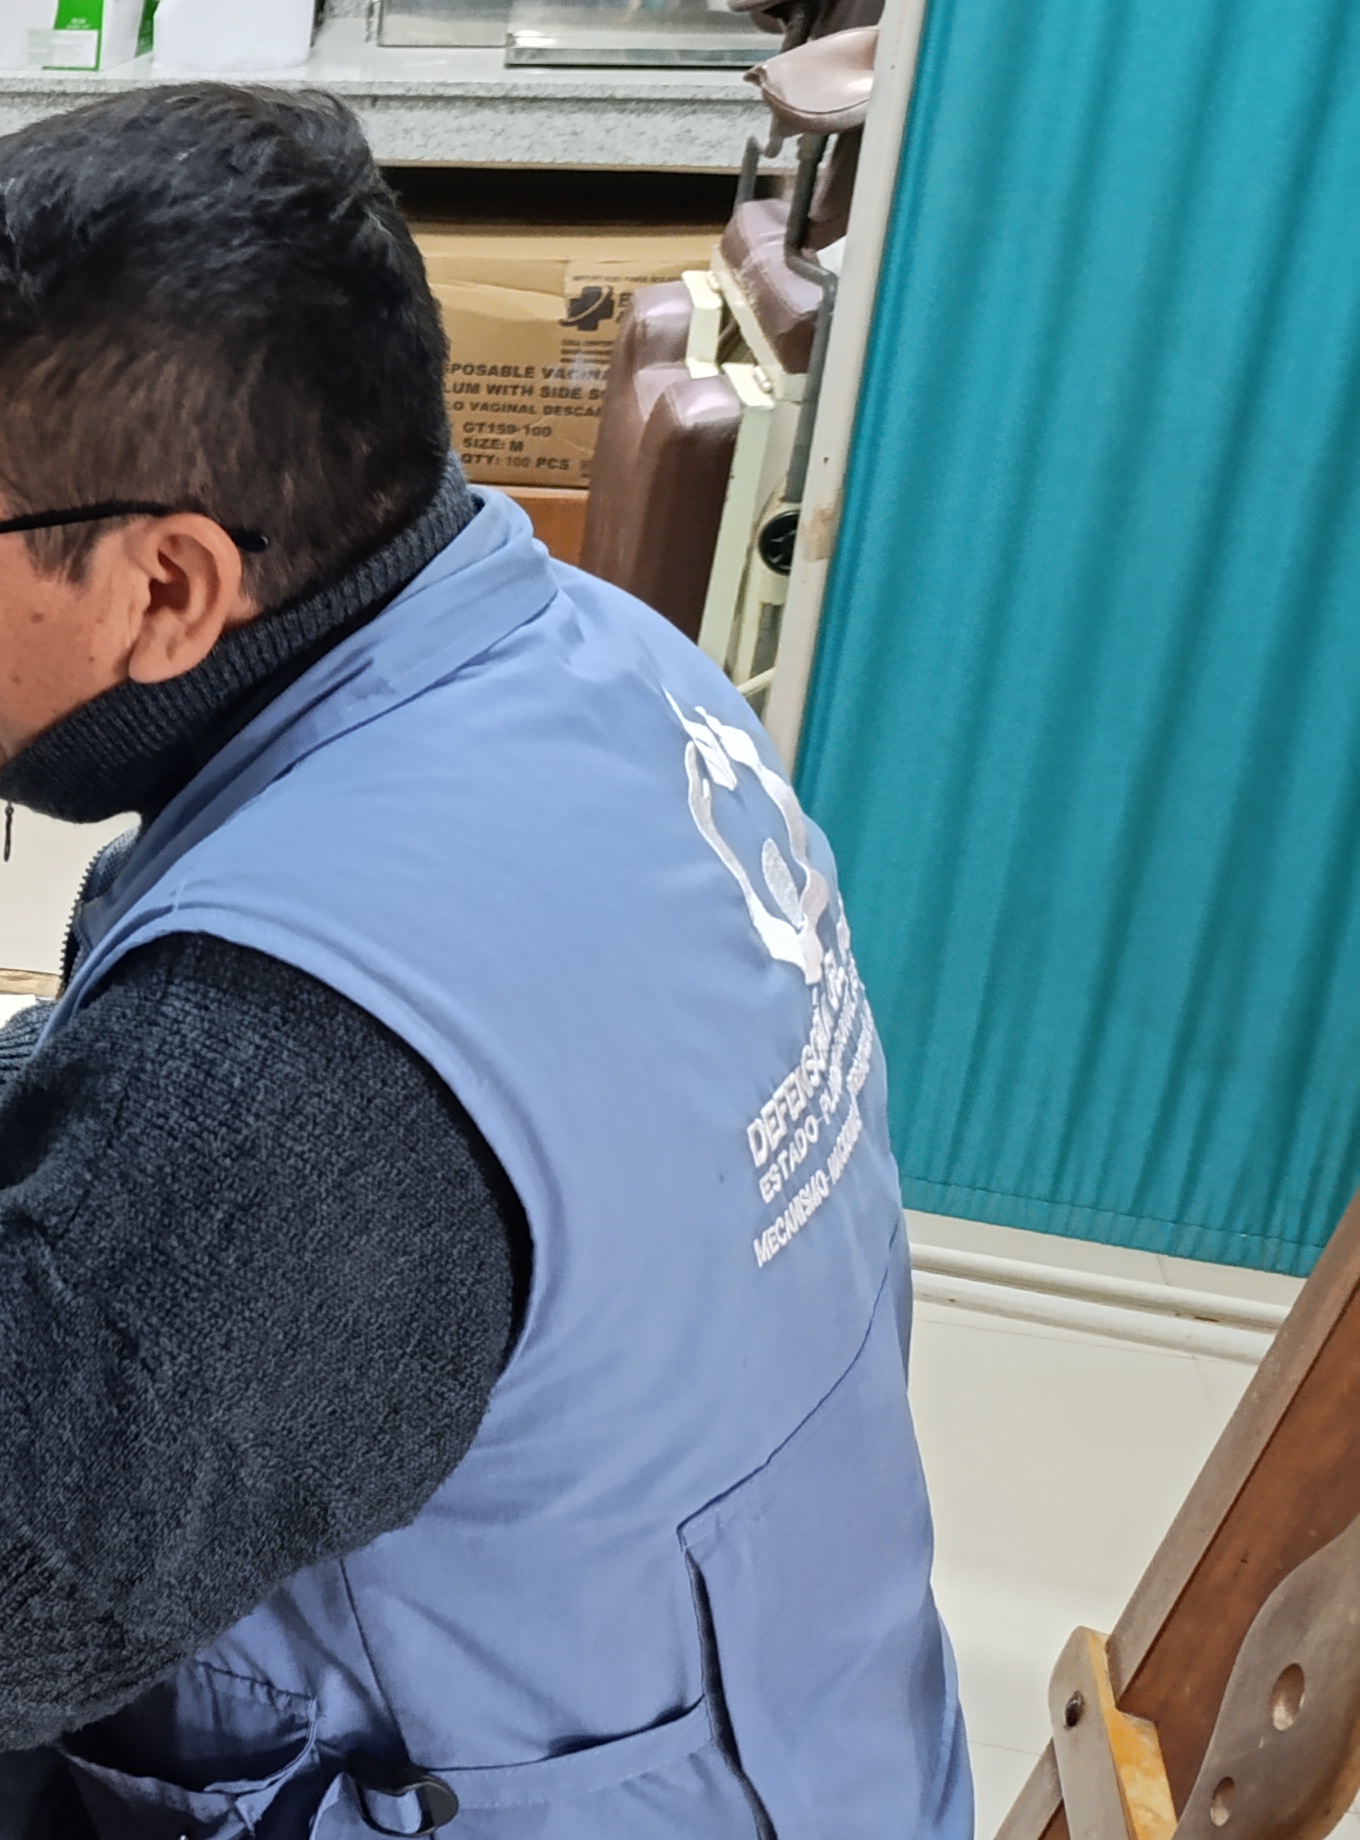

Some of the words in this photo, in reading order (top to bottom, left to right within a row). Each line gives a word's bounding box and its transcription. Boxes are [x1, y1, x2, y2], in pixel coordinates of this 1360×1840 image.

[486, 384, 534, 397] WITH
[539, 386, 583, 400] SIDE
[470, 401, 537, 415] VAGINAL
[509, 440, 524, 452] M
[461, 453, 500, 465] QTY:
[506, 456, 531, 468] 100
[535, 457, 570, 470] PCS
